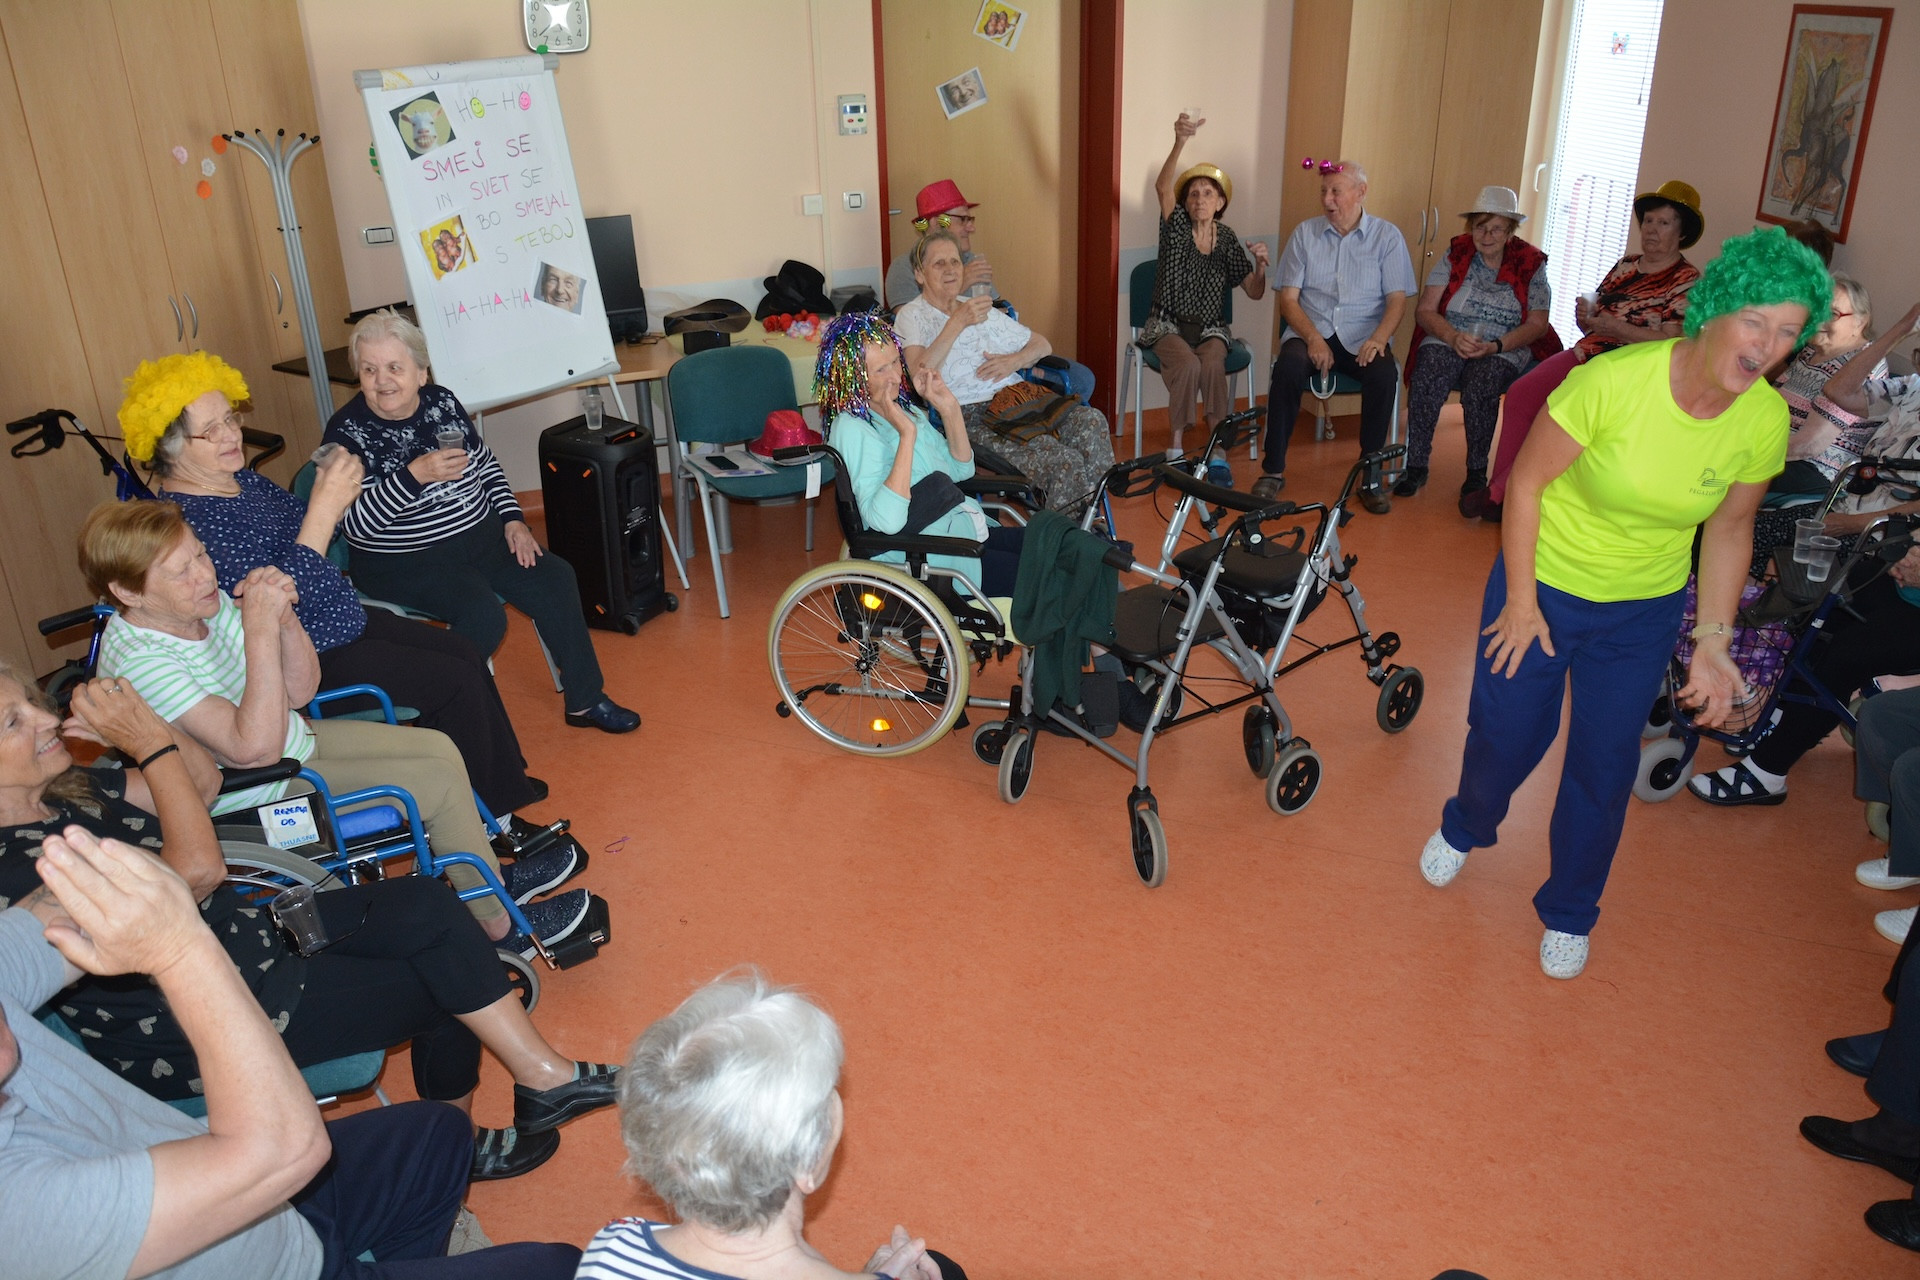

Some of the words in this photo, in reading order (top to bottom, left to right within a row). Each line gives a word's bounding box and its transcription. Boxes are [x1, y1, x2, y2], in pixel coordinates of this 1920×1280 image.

[531, 1, 540, 12] 10
[575, 1, 581, 11] 2
[530, 14, 536, 24] 9
[577, 14, 583, 25] 3
[532, 28, 538, 38] 8
[576, 28, 582, 38] 4
[543, 35, 549, 45] 7
[555, 36, 561, 46] 6
[567, 36, 573, 46] 5
[436, 192, 454, 211] IN
[470, 174, 510, 202] SVET
[520, 167, 544, 189] SE
[476, 211, 502, 230] BO
[515, 191, 571, 218] SMEJAL
[496, 247, 509, 265] S
[515, 217, 576, 253] TEBOJ
